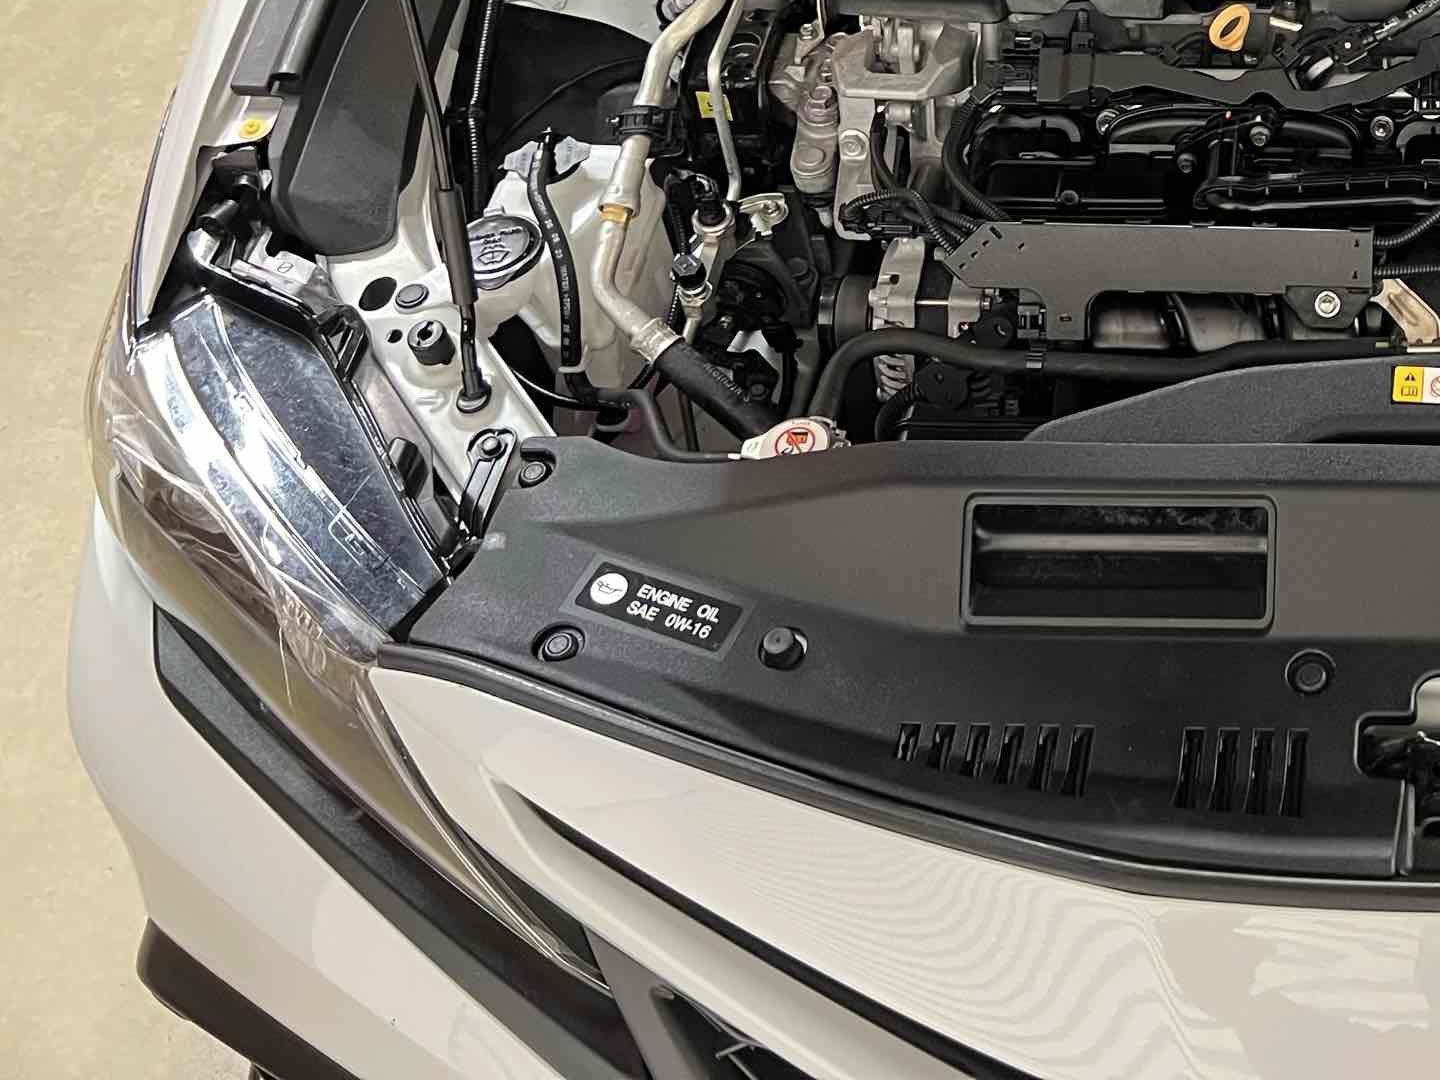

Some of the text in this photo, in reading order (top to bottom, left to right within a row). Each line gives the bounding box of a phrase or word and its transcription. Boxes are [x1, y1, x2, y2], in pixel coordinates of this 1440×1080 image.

[626, 601, 712, 639] SAE 0W-16
[637, 584, 719, 623] ENGINE OIL
